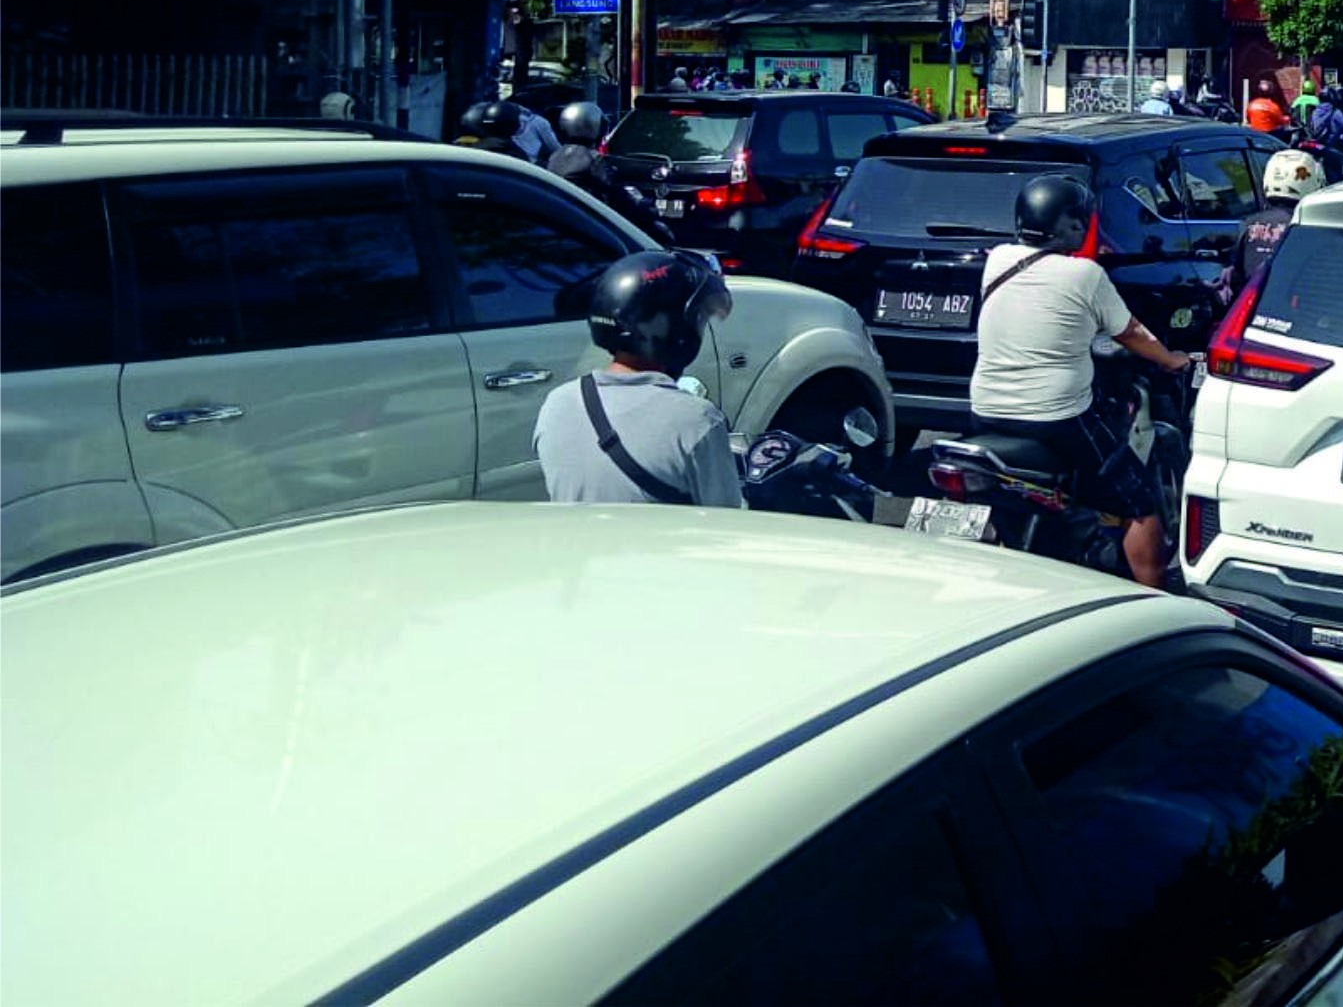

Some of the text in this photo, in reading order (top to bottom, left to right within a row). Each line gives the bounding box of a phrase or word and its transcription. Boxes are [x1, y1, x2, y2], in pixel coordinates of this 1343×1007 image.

[880, 289, 970, 313] L 1054 ABZ
